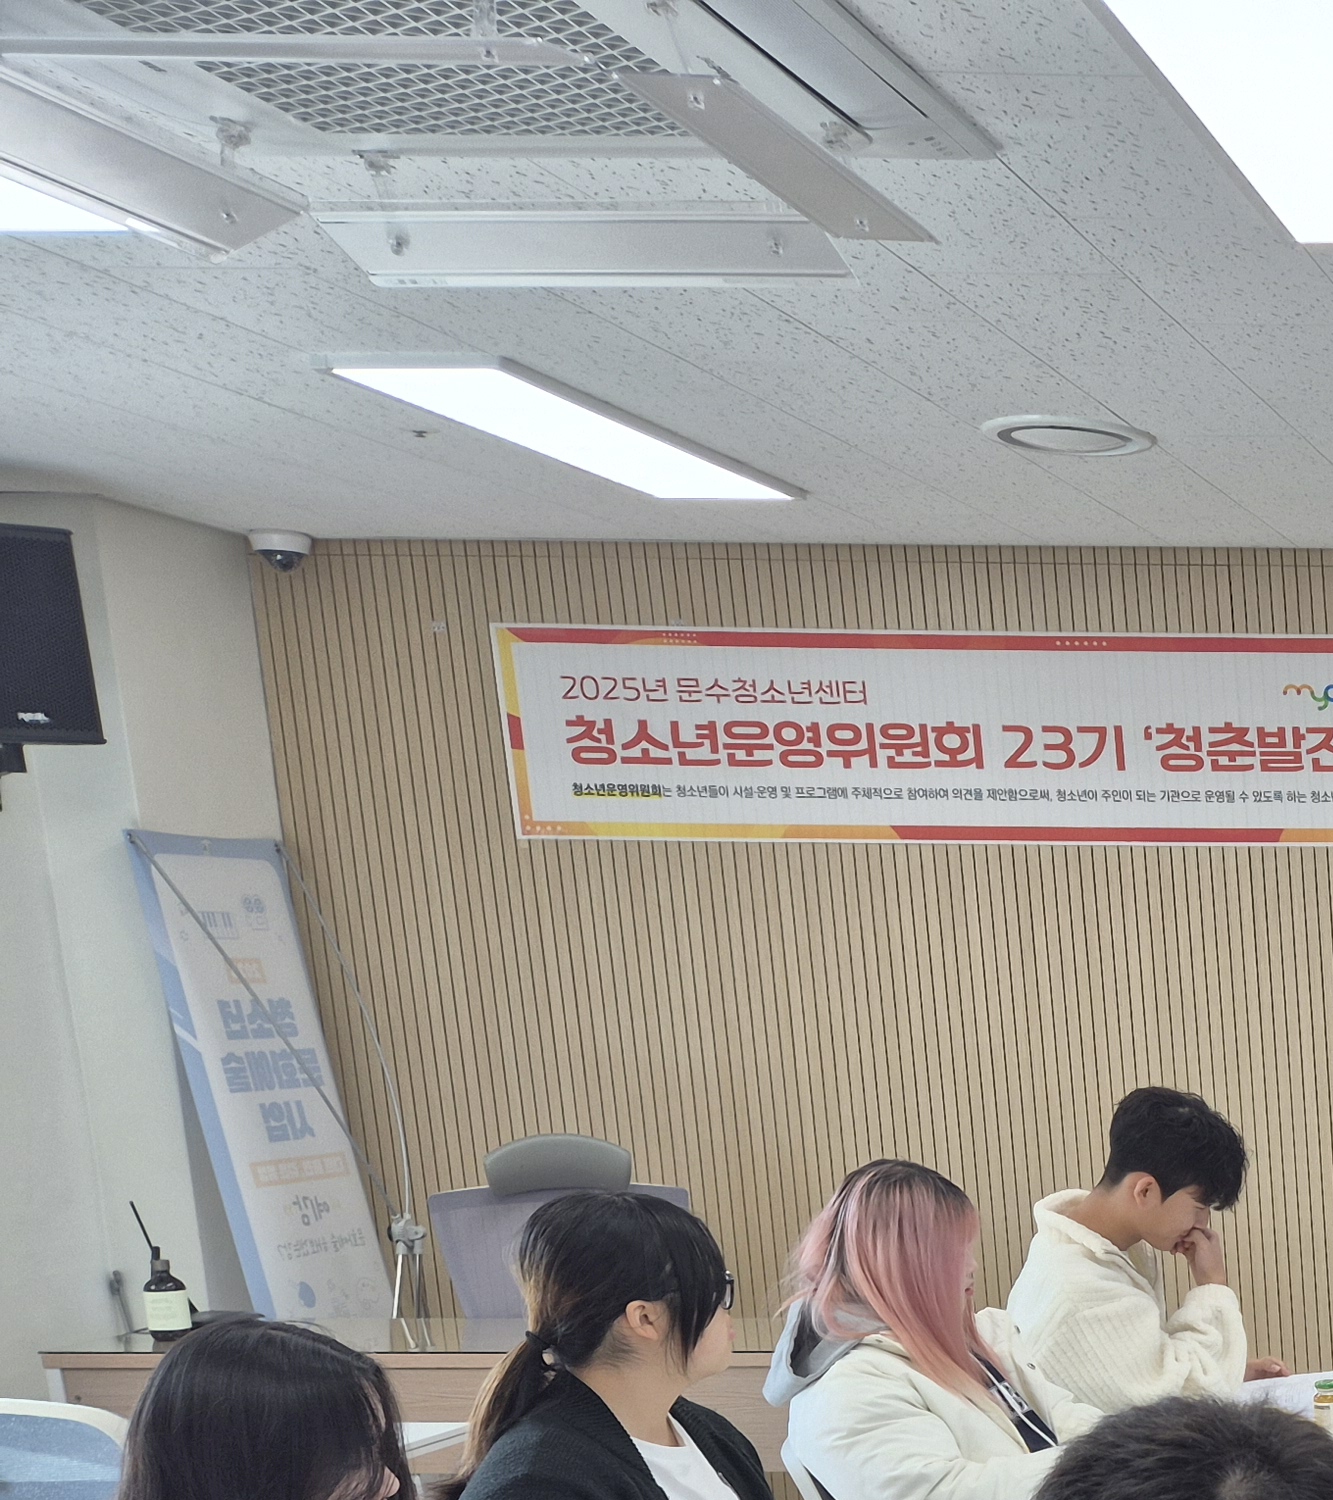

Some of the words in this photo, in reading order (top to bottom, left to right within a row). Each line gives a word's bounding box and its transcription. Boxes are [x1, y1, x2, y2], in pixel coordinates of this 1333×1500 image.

[560, 675, 668, 702] 2025년
[676, 676, 868, 705] 문수청소년센터
[565, 715, 984, 770] 청소년운영위원회
[1002, 724, 1126, 771] 23기
[572, 783, 672, 797] 청소년운영위원회는
[676, 784, 729, 798] 청소년들이
[781, 784, 792, 799] 및
[796, 785, 848, 799] 프로그램에
[851, 785, 904, 799] 주체적으로
[908, 786, 949, 800] 참여하여
[952, 786, 983, 800] 의견을
[986, 786, 1052, 800] 제안함으로써,
[1056, 787, 1097, 801] 청소년이
[1101, 787, 1132, 801] 주인이
[1136, 788, 1155, 801] 되는
[1160, 788, 1201, 801] 기관으로
[1205, 788, 1235, 802] 운영될
[1239, 788, 1249, 802] 수
[1252, 789, 1283, 802] 있도록
[1286, 789, 1307, 802] 하는
